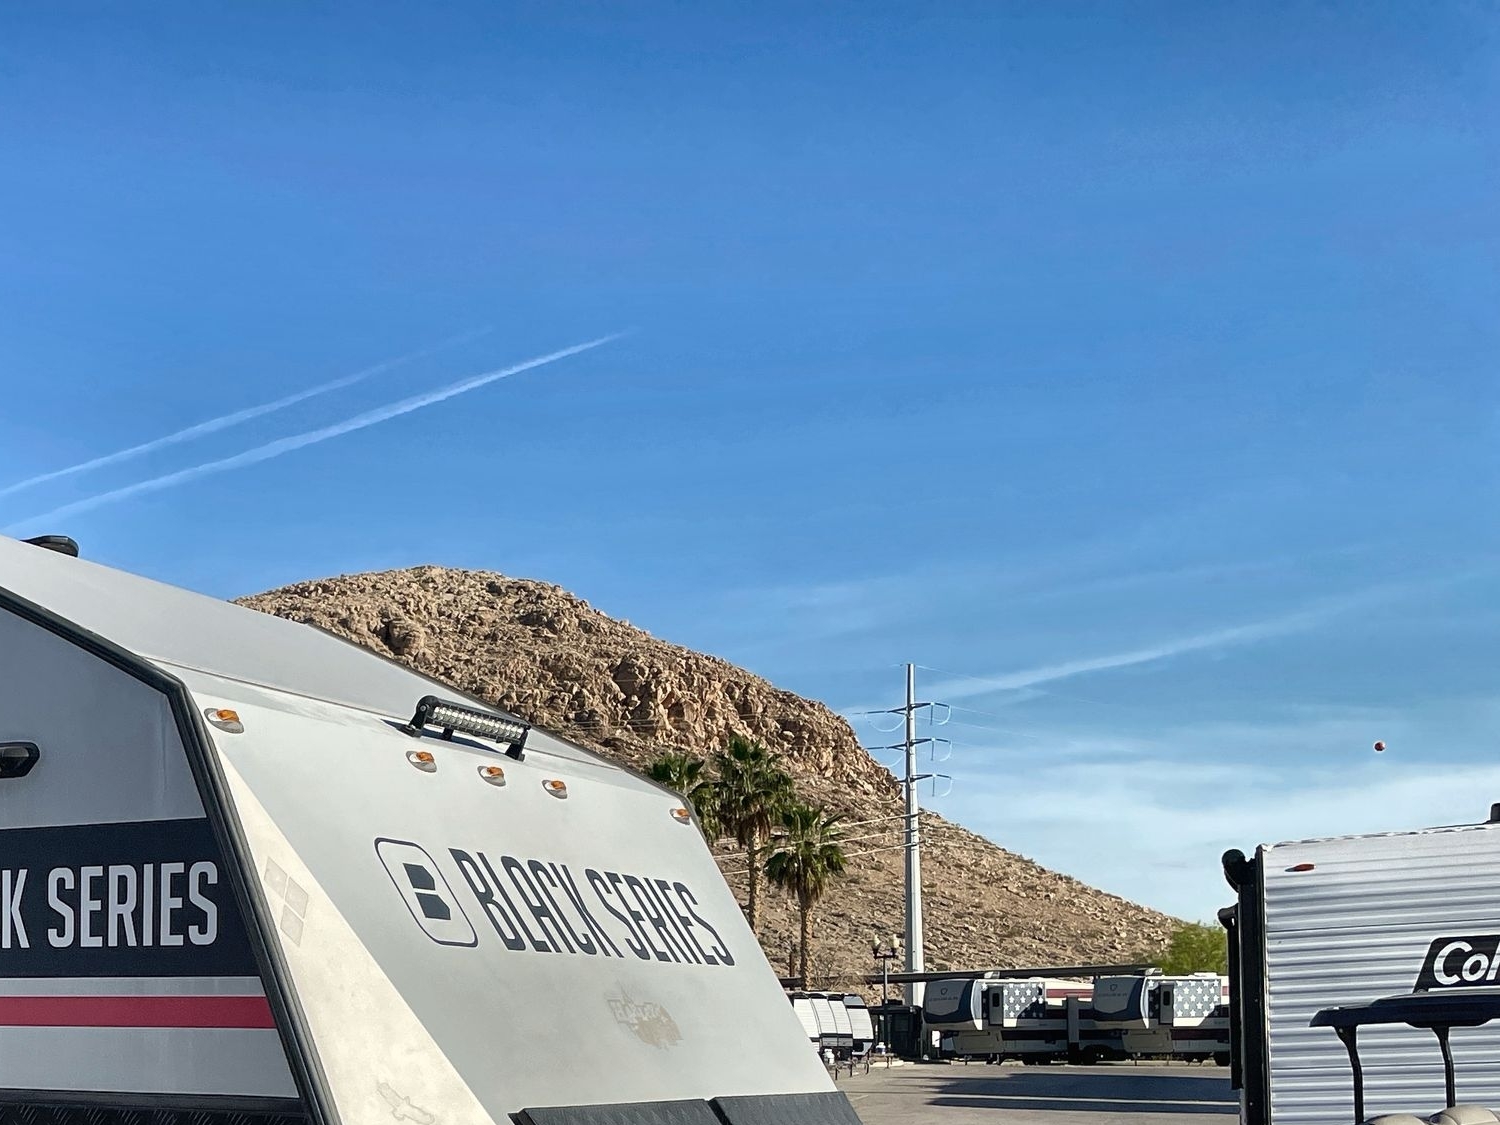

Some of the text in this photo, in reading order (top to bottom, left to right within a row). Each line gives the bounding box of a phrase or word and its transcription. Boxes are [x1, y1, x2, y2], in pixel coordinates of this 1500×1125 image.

[47, 861, 218, 948] SERIES
[447, 847, 736, 967] BLACK SERIES
